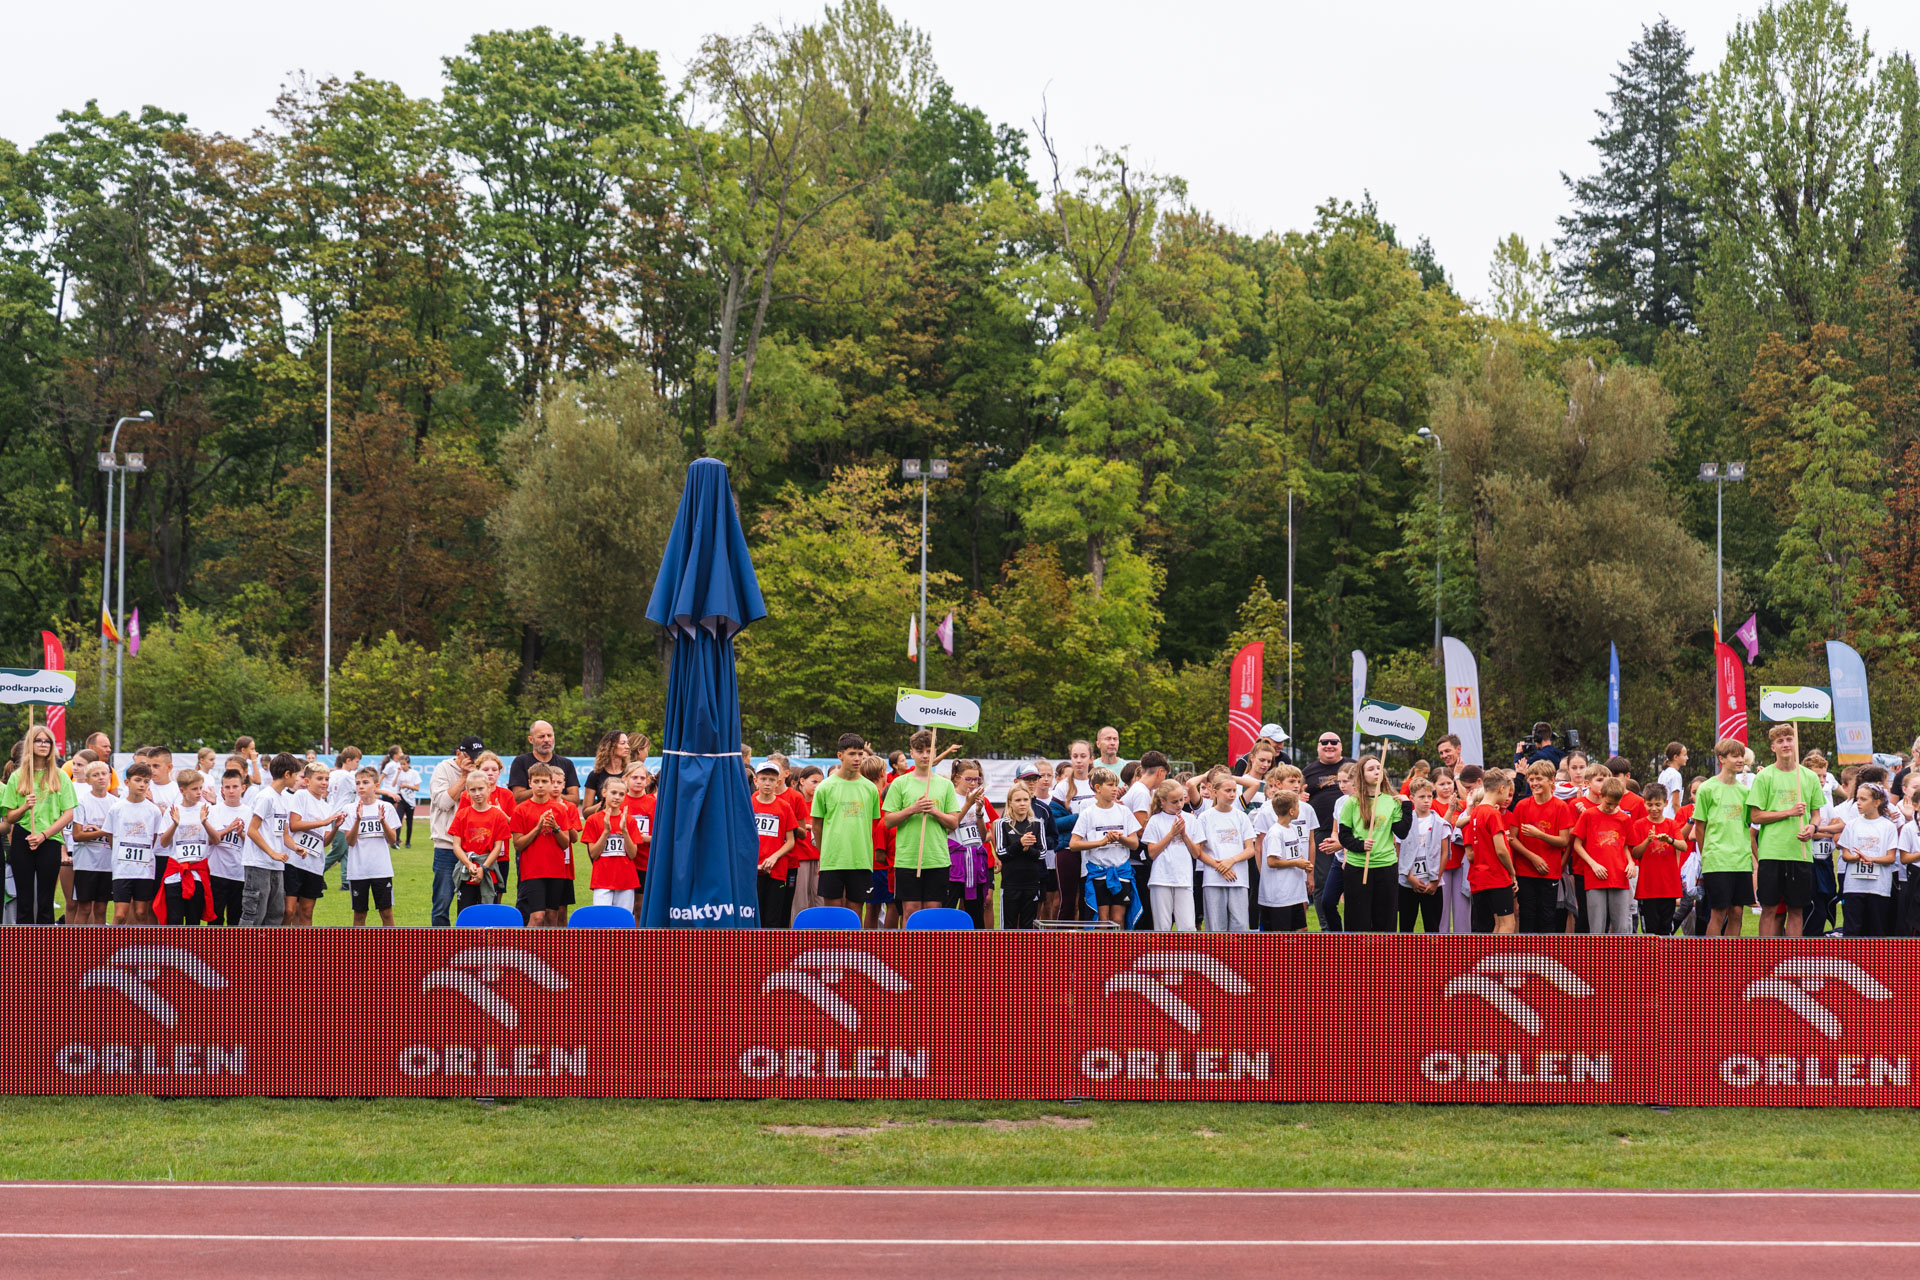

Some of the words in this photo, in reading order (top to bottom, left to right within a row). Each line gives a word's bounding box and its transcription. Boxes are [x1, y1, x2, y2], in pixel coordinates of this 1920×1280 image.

[0, 684, 63, 694] podkarpackie
[919, 706, 957, 717] opolskie
[1773, 701, 1819, 710] małopolskie
[1368, 716, 1416, 732] mazowieckie
[361, 820, 381, 833] 299
[299, 834, 320, 849] 317
[605, 839, 623, 852] 292
[125, 848, 144, 861] 311
[182, 845, 202, 857] 321
[57, 1043, 246, 1075] ORLEN
[400, 1044, 587, 1076] ORLEN
[739, 1046, 929, 1078] ORLEN
[1081, 1048, 1269, 1080] ORLEN
[1420, 1050, 1612, 1082] ORLEN
[1719, 1053, 1911, 1086] ORLEN
